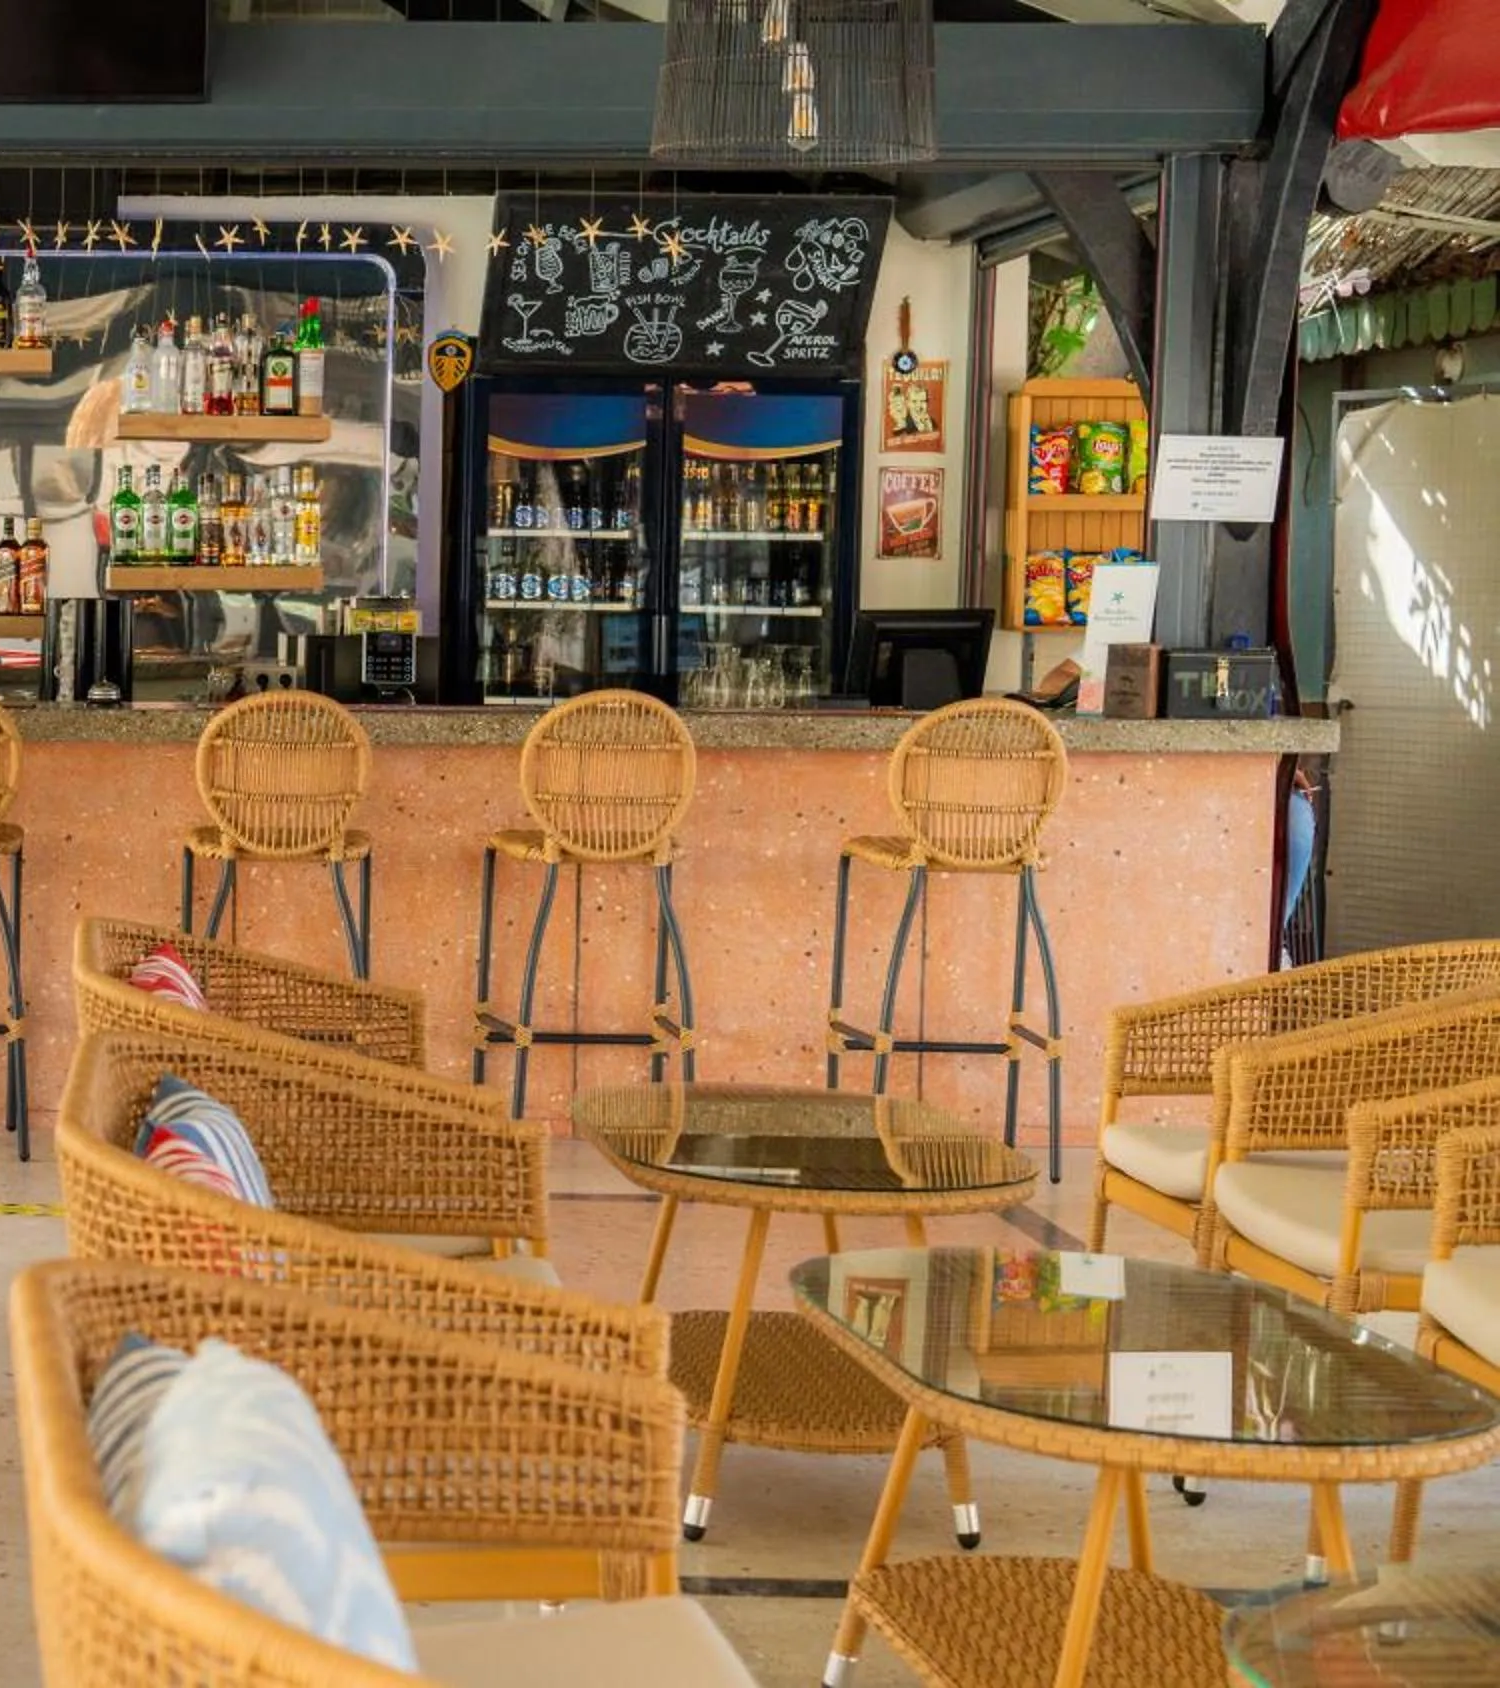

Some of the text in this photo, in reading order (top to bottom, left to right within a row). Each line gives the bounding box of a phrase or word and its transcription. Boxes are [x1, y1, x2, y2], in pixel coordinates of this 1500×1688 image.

[652, 215, 770, 255] Cocktails
[510, 257, 527, 282] SEX
[783, 347, 830, 359] SPRITZ
[885, 472, 939, 494] COFFEE
